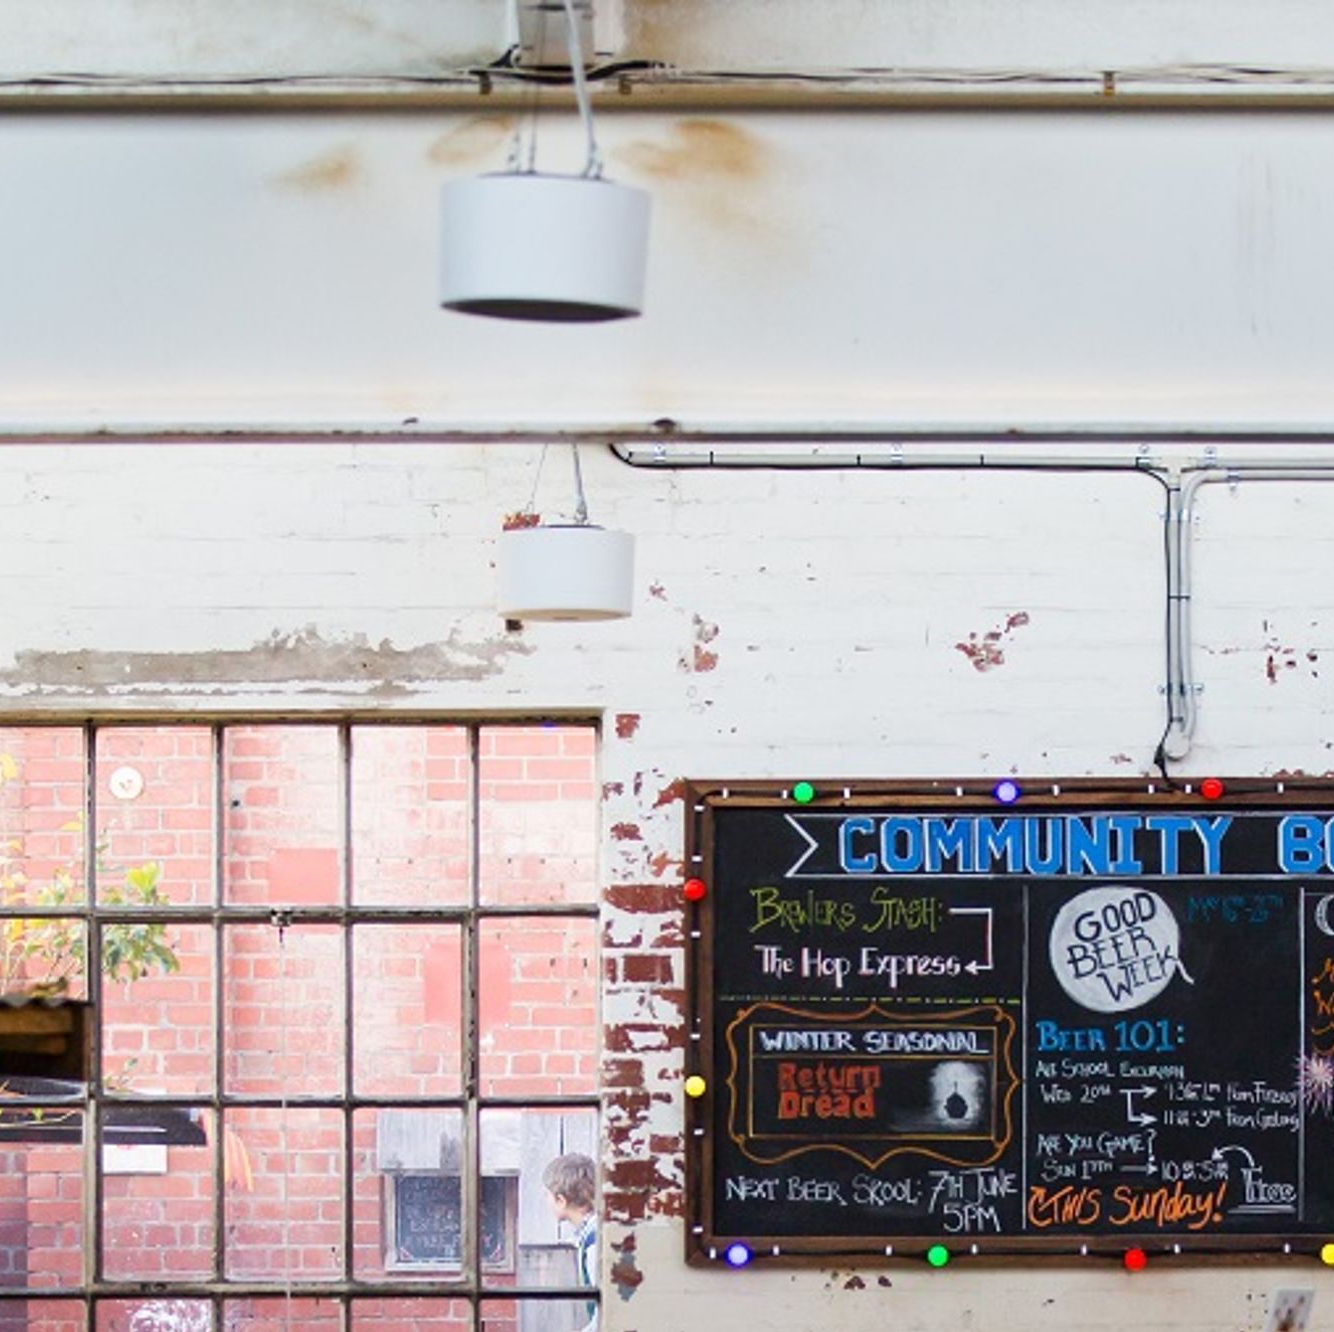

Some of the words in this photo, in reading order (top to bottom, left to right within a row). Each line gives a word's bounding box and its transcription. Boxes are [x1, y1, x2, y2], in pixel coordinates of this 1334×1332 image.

[838, 816, 1233, 874] COMMUNITY
[1074, 892, 1157, 943] GOOD
[754, 944, 794, 979] The
[801, 947, 851, 988] Hop
[859, 947, 961, 988] Express
[1067, 926, 1157, 979] BEER
[1096, 944, 1194, 1002] WEEK
[759, 1031, 857, 1052] WINTER
[866, 1031, 989, 1054] SEASONAL
[1036, 1021, 1107, 1052] BEER
[1114, 1019, 1186, 1053] 101:
[777, 1062, 883, 1090] Return
[777, 1090, 876, 1120] Dread
[726, 1176, 780, 1201] NEXT
[787, 1176, 848, 1206] BEER
[943, 1203, 1002, 1233] 5PM
